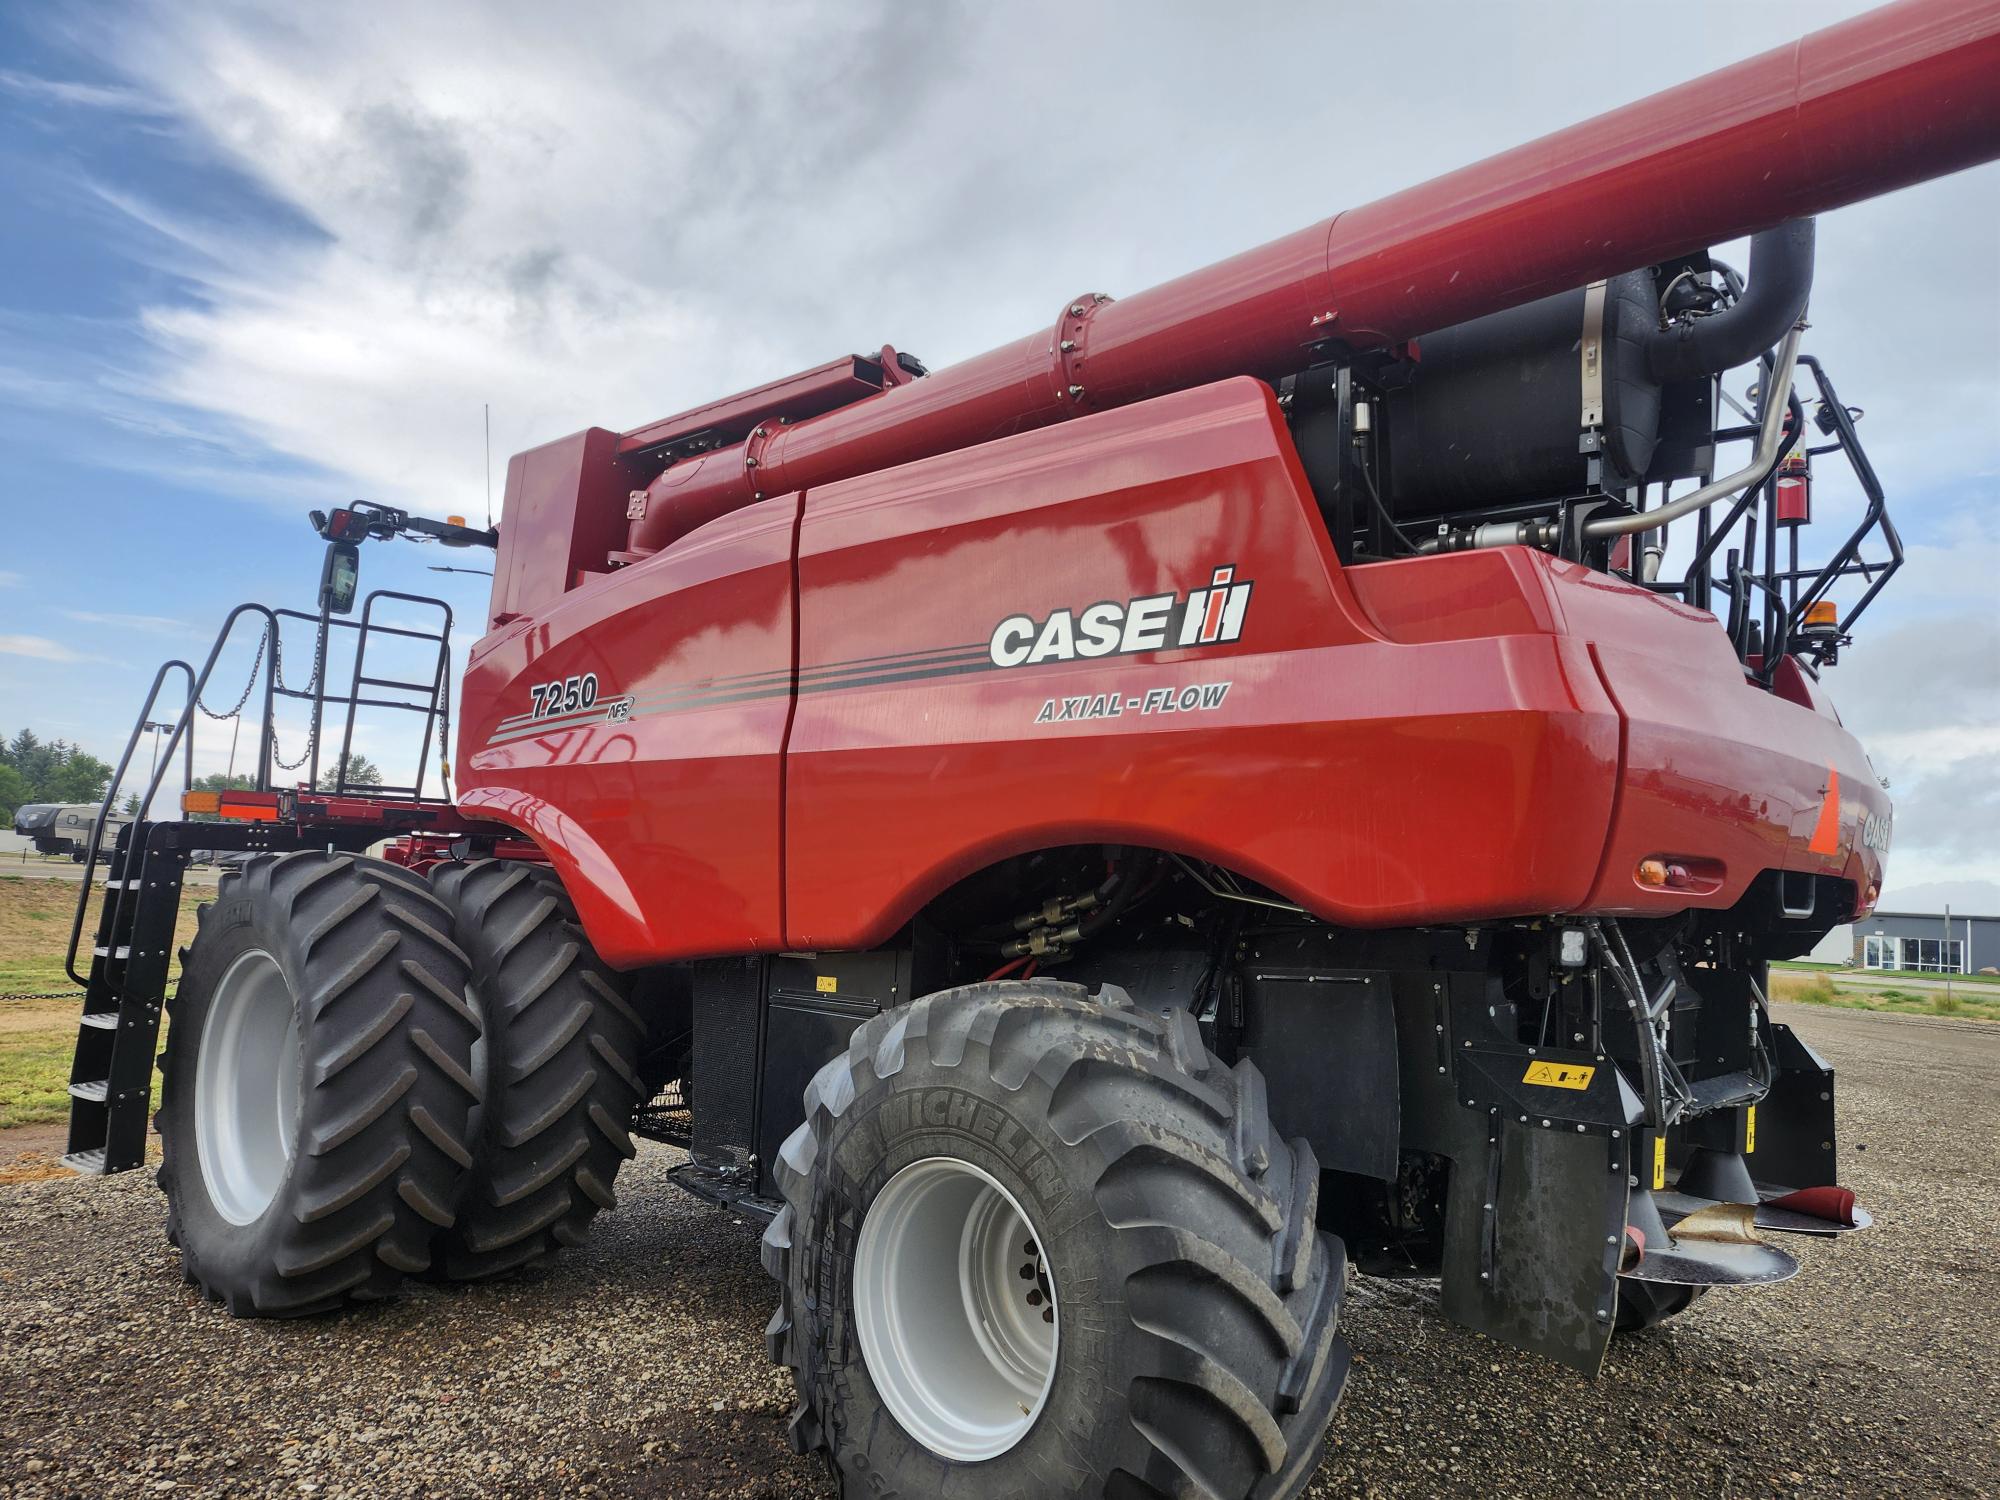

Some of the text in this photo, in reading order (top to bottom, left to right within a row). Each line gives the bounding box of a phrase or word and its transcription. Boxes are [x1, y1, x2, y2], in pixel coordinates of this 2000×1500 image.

[989, 593, 1176, 667] CASE
[531, 672, 630, 720] 7250 AFS
[1034, 682, 1232, 724] AXIAL-FLOW
[879, 1087, 1065, 1201] MICHELIN
